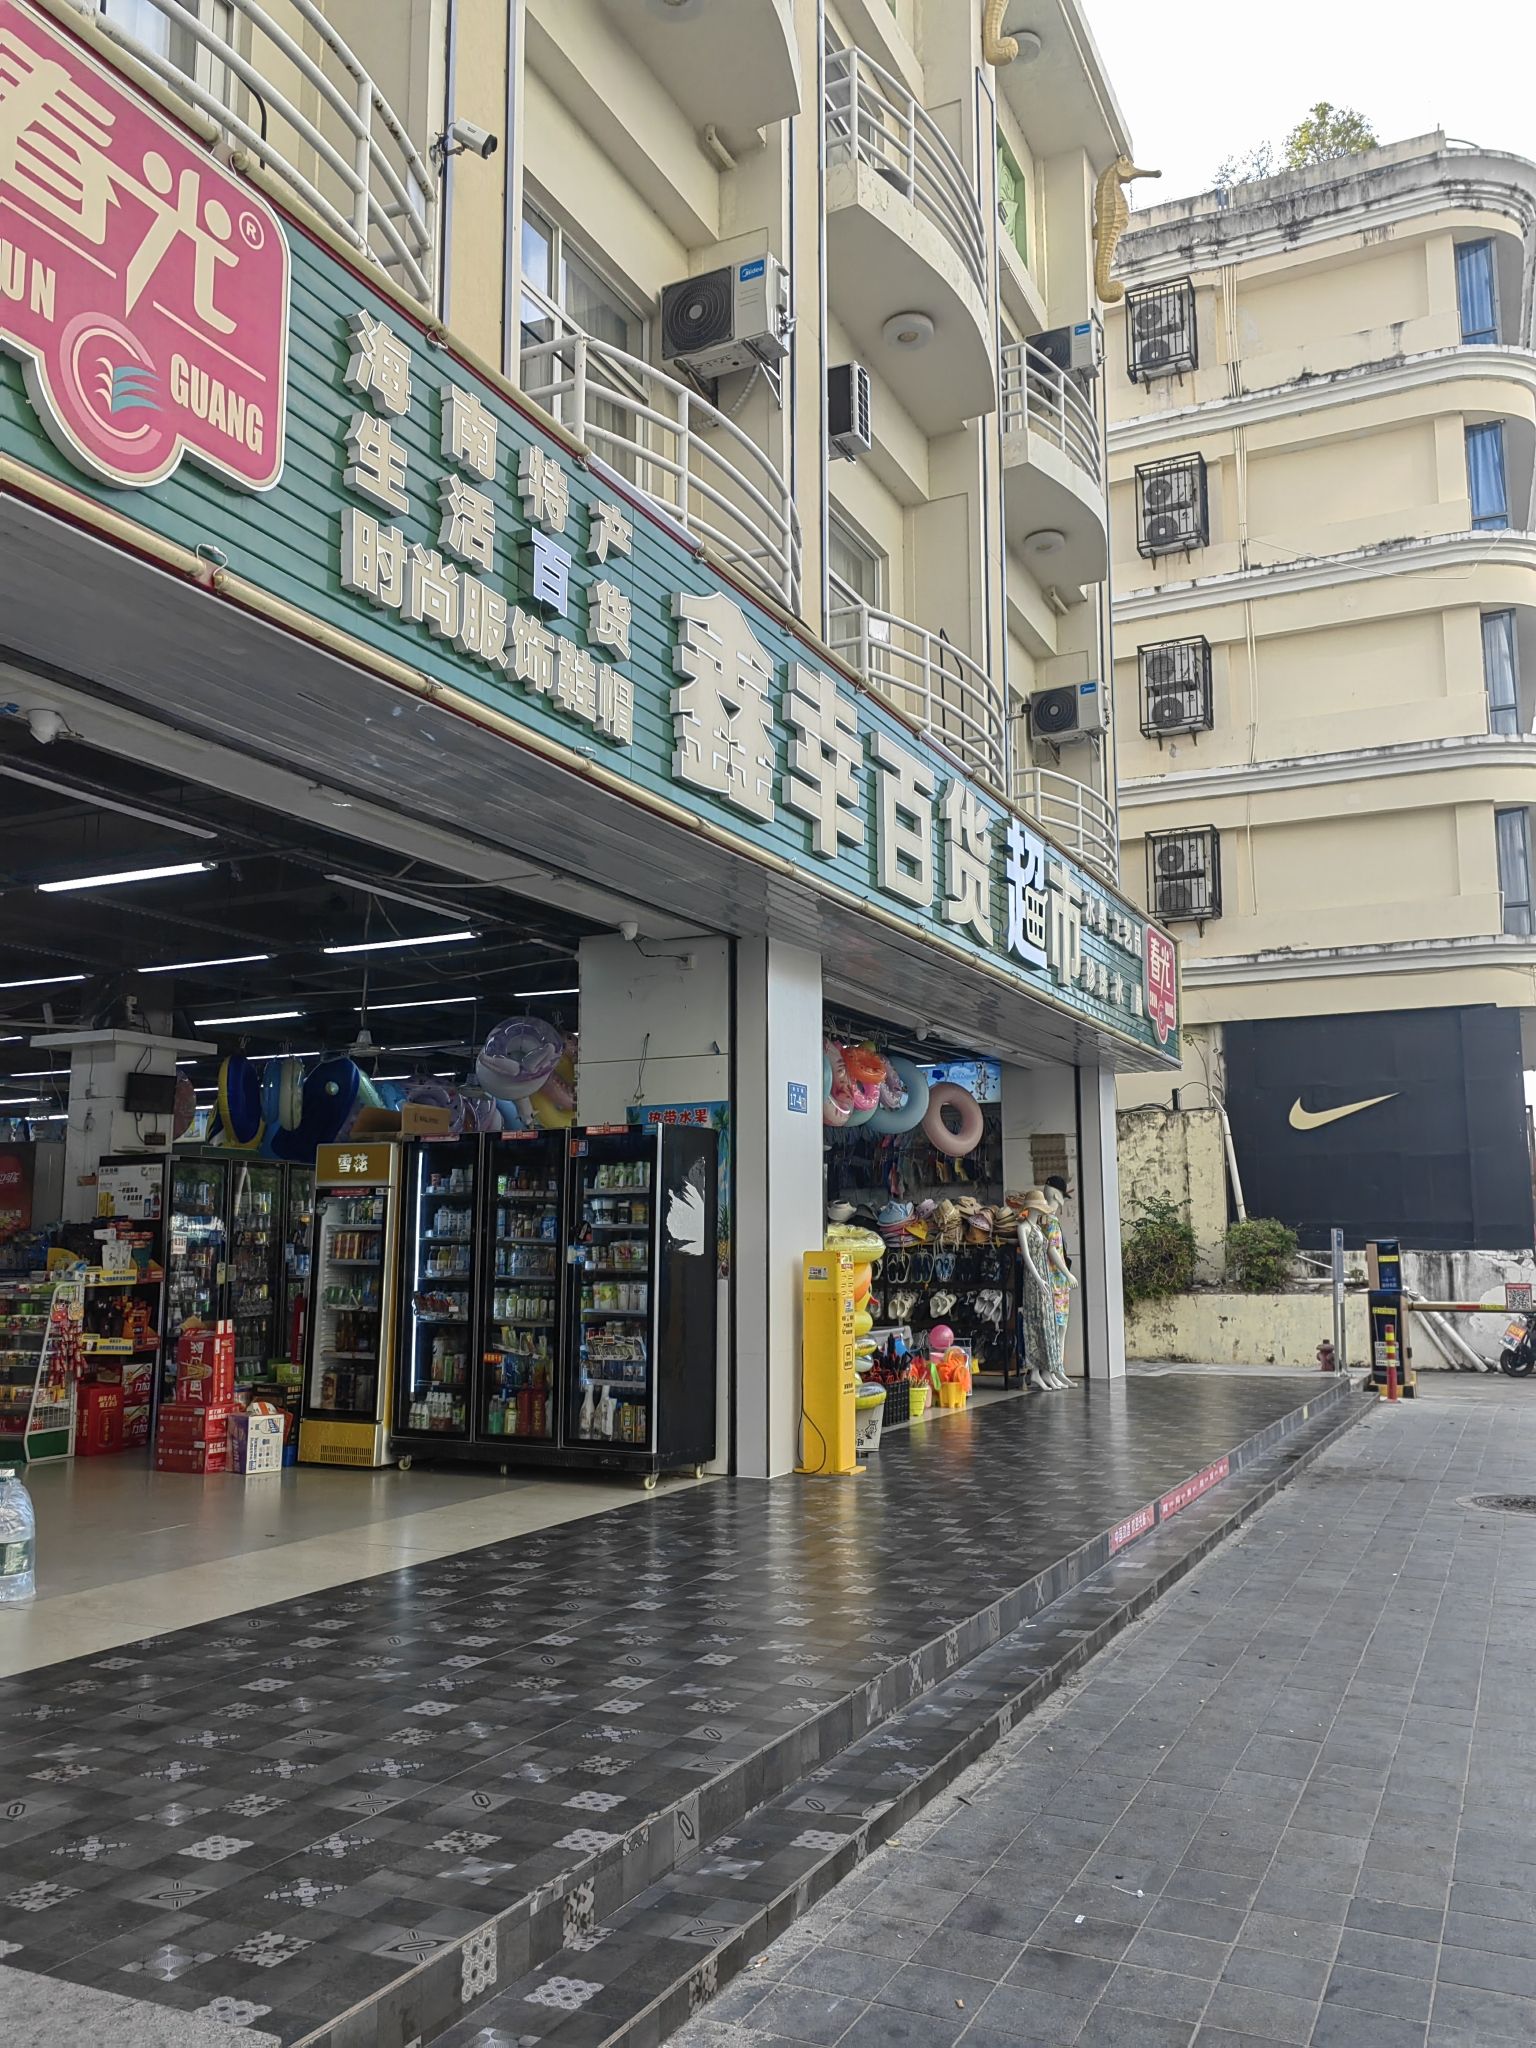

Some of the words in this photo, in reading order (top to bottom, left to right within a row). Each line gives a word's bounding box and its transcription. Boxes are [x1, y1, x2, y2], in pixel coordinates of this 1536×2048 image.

[170, 353, 264, 455] GUANG
[343, 309, 633, 563] 海南特产
[341, 508, 634, 746] 时尚服饰鞋帽
[344, 412, 632, 661] 生活百货
[670, 591, 1083, 987] 鑫幸百货超市
[1150, 936, 1170, 997] 春光
[338, 1153, 368, 1172] 雪花
